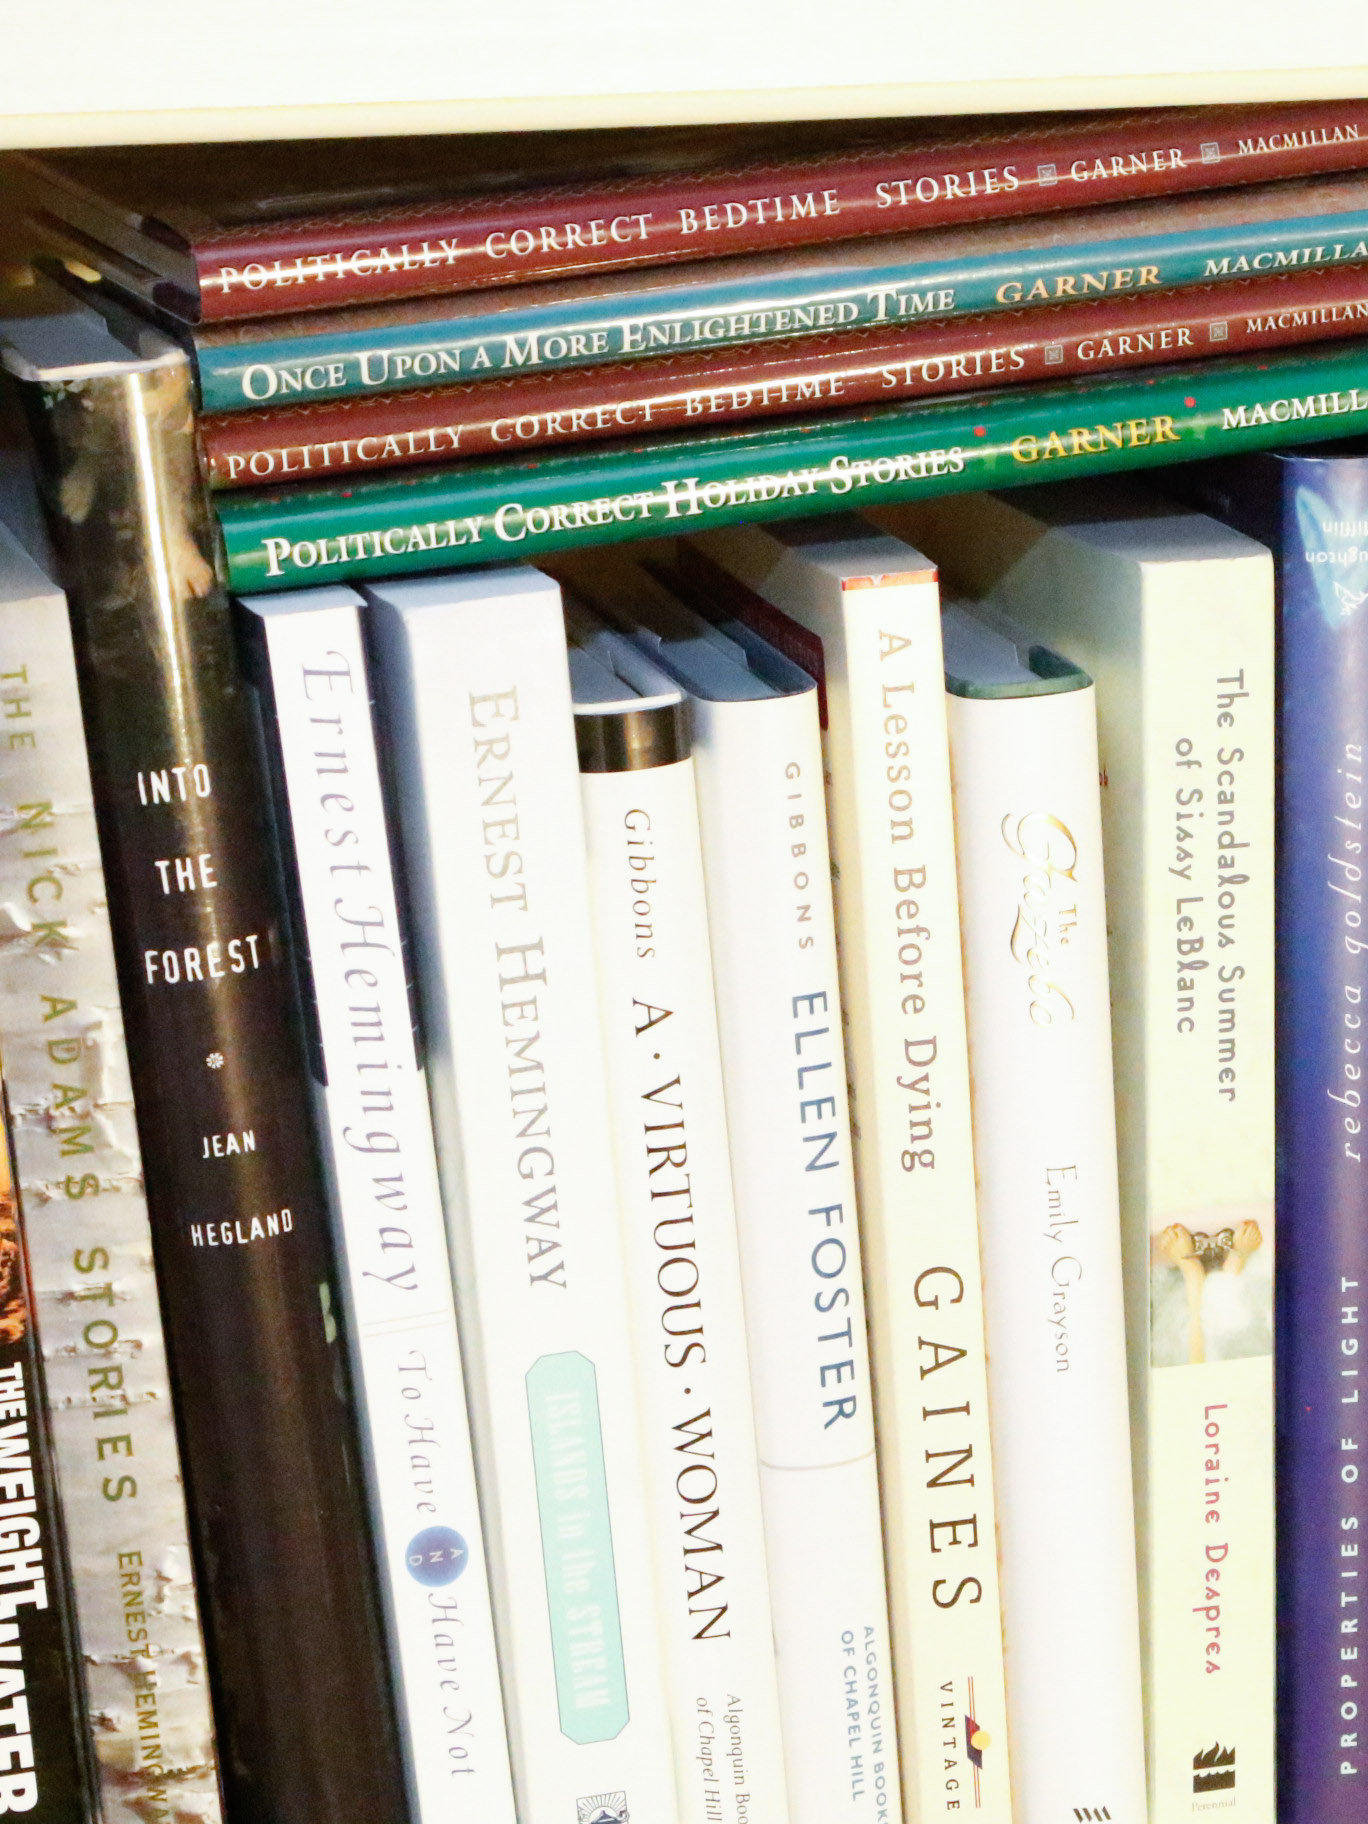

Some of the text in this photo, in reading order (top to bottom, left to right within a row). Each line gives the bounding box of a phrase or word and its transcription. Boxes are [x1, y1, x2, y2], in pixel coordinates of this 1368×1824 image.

[220, 124, 1359, 294] POLITICALLY CORRECT BEDTIME STORIES GARNER MACMILLAN
[228, 424, 465, 479] POLITICALLY
[491, 401, 656, 443] CORRECT
[684, 372, 846, 416] BEDTIME
[882, 347, 1026, 389] STORIES
[1077, 327, 1194, 361] GARNER
[242, 364, 346, 400] ONCE
[359, 349, 460, 386] UPON
[472, 354, 491, 370] A
[504, 330, 608, 368] MORE
[867, 286, 955, 321] TIME
[996, 264, 1161, 304] GARNER
[263, 516, 484, 578] POLITICALLY
[493, 491, 654, 543] CORRECT
[830, 446, 965, 496] STORIES
[1010, 415, 1181, 463] GARNER
[1, 664, 36, 749] THE
[138, 763, 213, 806] INTO
[17, 800, 78, 963] NICK
[154, 853, 219, 894] THE
[623, 808, 656, 961] Gibbons
[784, 761, 814, 951] GIBBONS
[878, 629, 940, 1171] A Lesson Before Dying
[1059, 904, 1077, 944] The
[1168, 737, 1209, 1035] of Sissy LeBlanc
[1217, 669, 1250, 1103] The Scandalous Summer
[145, 934, 261, 985] FOREST
[302, 649, 420, 1293] Ernest Hemingway
[468, 685, 567, 1289] ERNEST HEMINGWAY
[40, 995, 101, 1200] ADAMS
[201, 1130, 256, 1159] JEAN
[1328, 984, 1361, 1164] rebecca
[191, 1209, 294, 1248] HEGLAND
[791, 990, 857, 1430] ELLEN FOSTER
[1044, 1163, 1083, 1373] Emily Grayson
[0, 1361, 27, 1420] THE
[73, 1246, 138, 1503] STORIES
[631, 997, 731, 1641] A VIRTUOUS WOMAN
[0, 1420, 48, 1612] WEIGHT
[913, 1265, 982, 1610] GAINES
[118, 1551, 152, 1660] ERNEST
[398, 1350, 475, 1778] To Have AND Have Not
[546, 1391, 610, 1710] ISLANDS in the STREAM
[1192, 1403, 1229, 1676] Loraine Despres
[1340, 1276, 1359, 1775] PROPERTIES OF LIGHT
[696, 1697, 723, 1822] of Chapel Hill
[723, 1694, 749, 1786] Algonquin
[841, 1630, 865, 1801] OF CHAPEL HILL
[863, 1625, 889, 1824] ALGONQUIN BOOK
[940, 1680, 960, 1811] VINTAGE
[1191, 1796, 1236, 1812] Perennial
